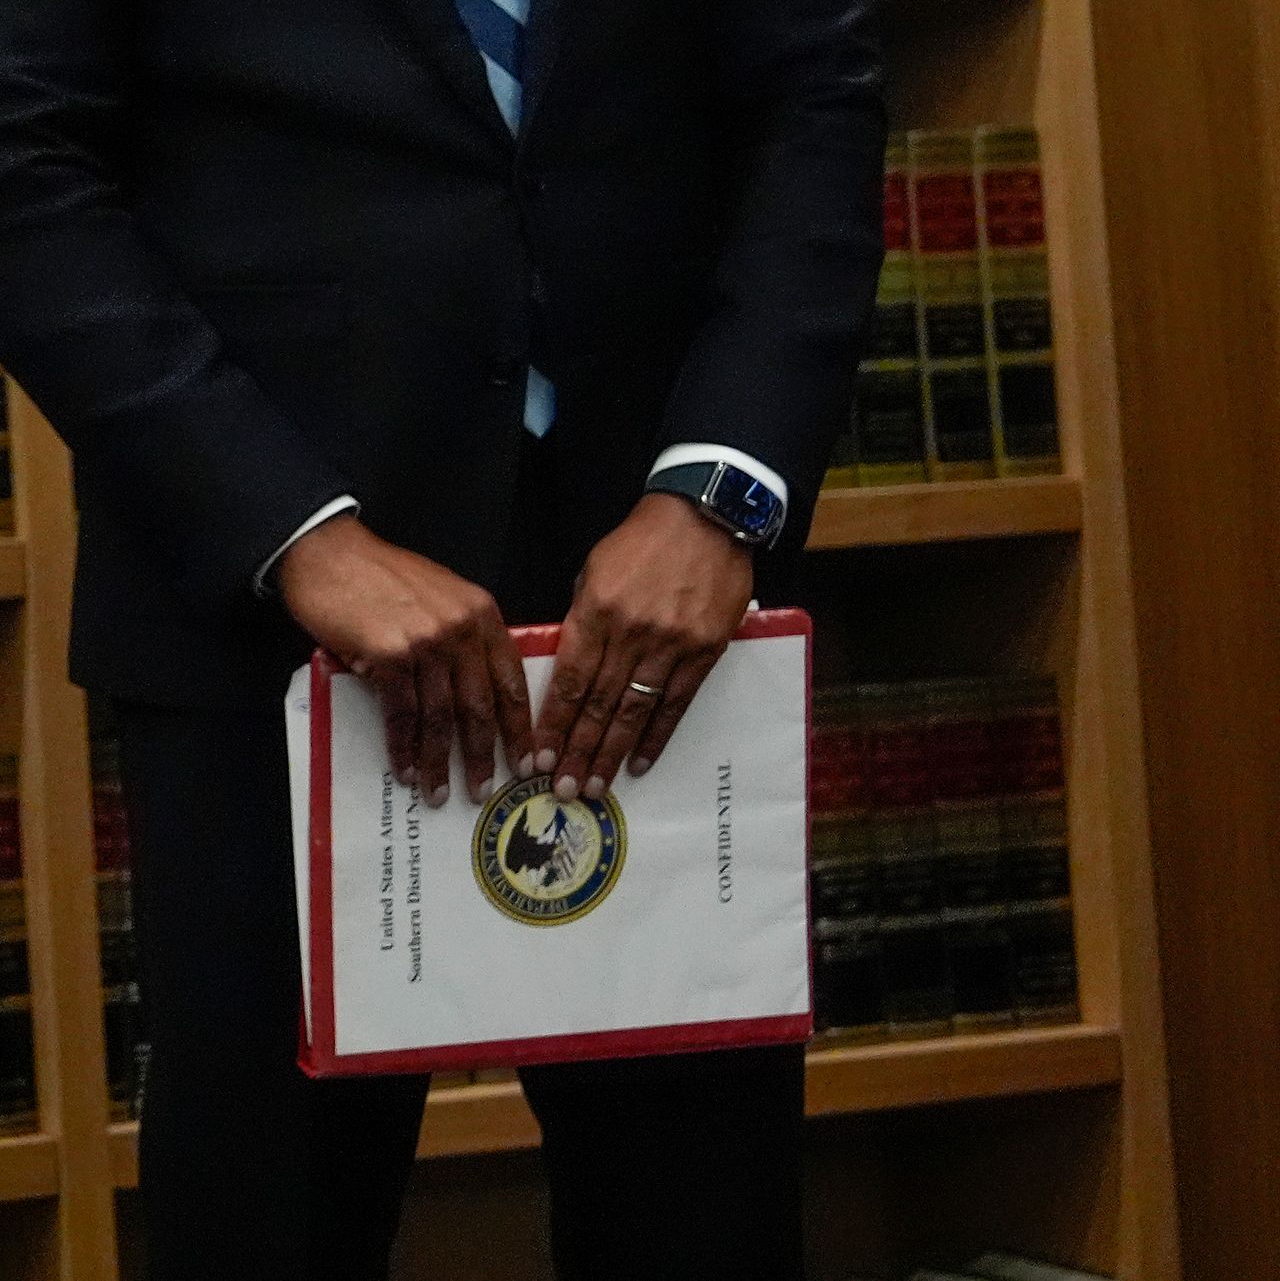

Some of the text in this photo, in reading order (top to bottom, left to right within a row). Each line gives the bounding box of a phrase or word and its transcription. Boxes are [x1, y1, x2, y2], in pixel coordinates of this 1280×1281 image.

[406, 818, 420, 840] Of
[717, 758, 733, 904] CONFIDENTIAL
[381, 844, 394, 894] States
[406, 844, 421, 905] District
[380, 897, 394, 951] United
[407, 909, 422, 983] Southern
